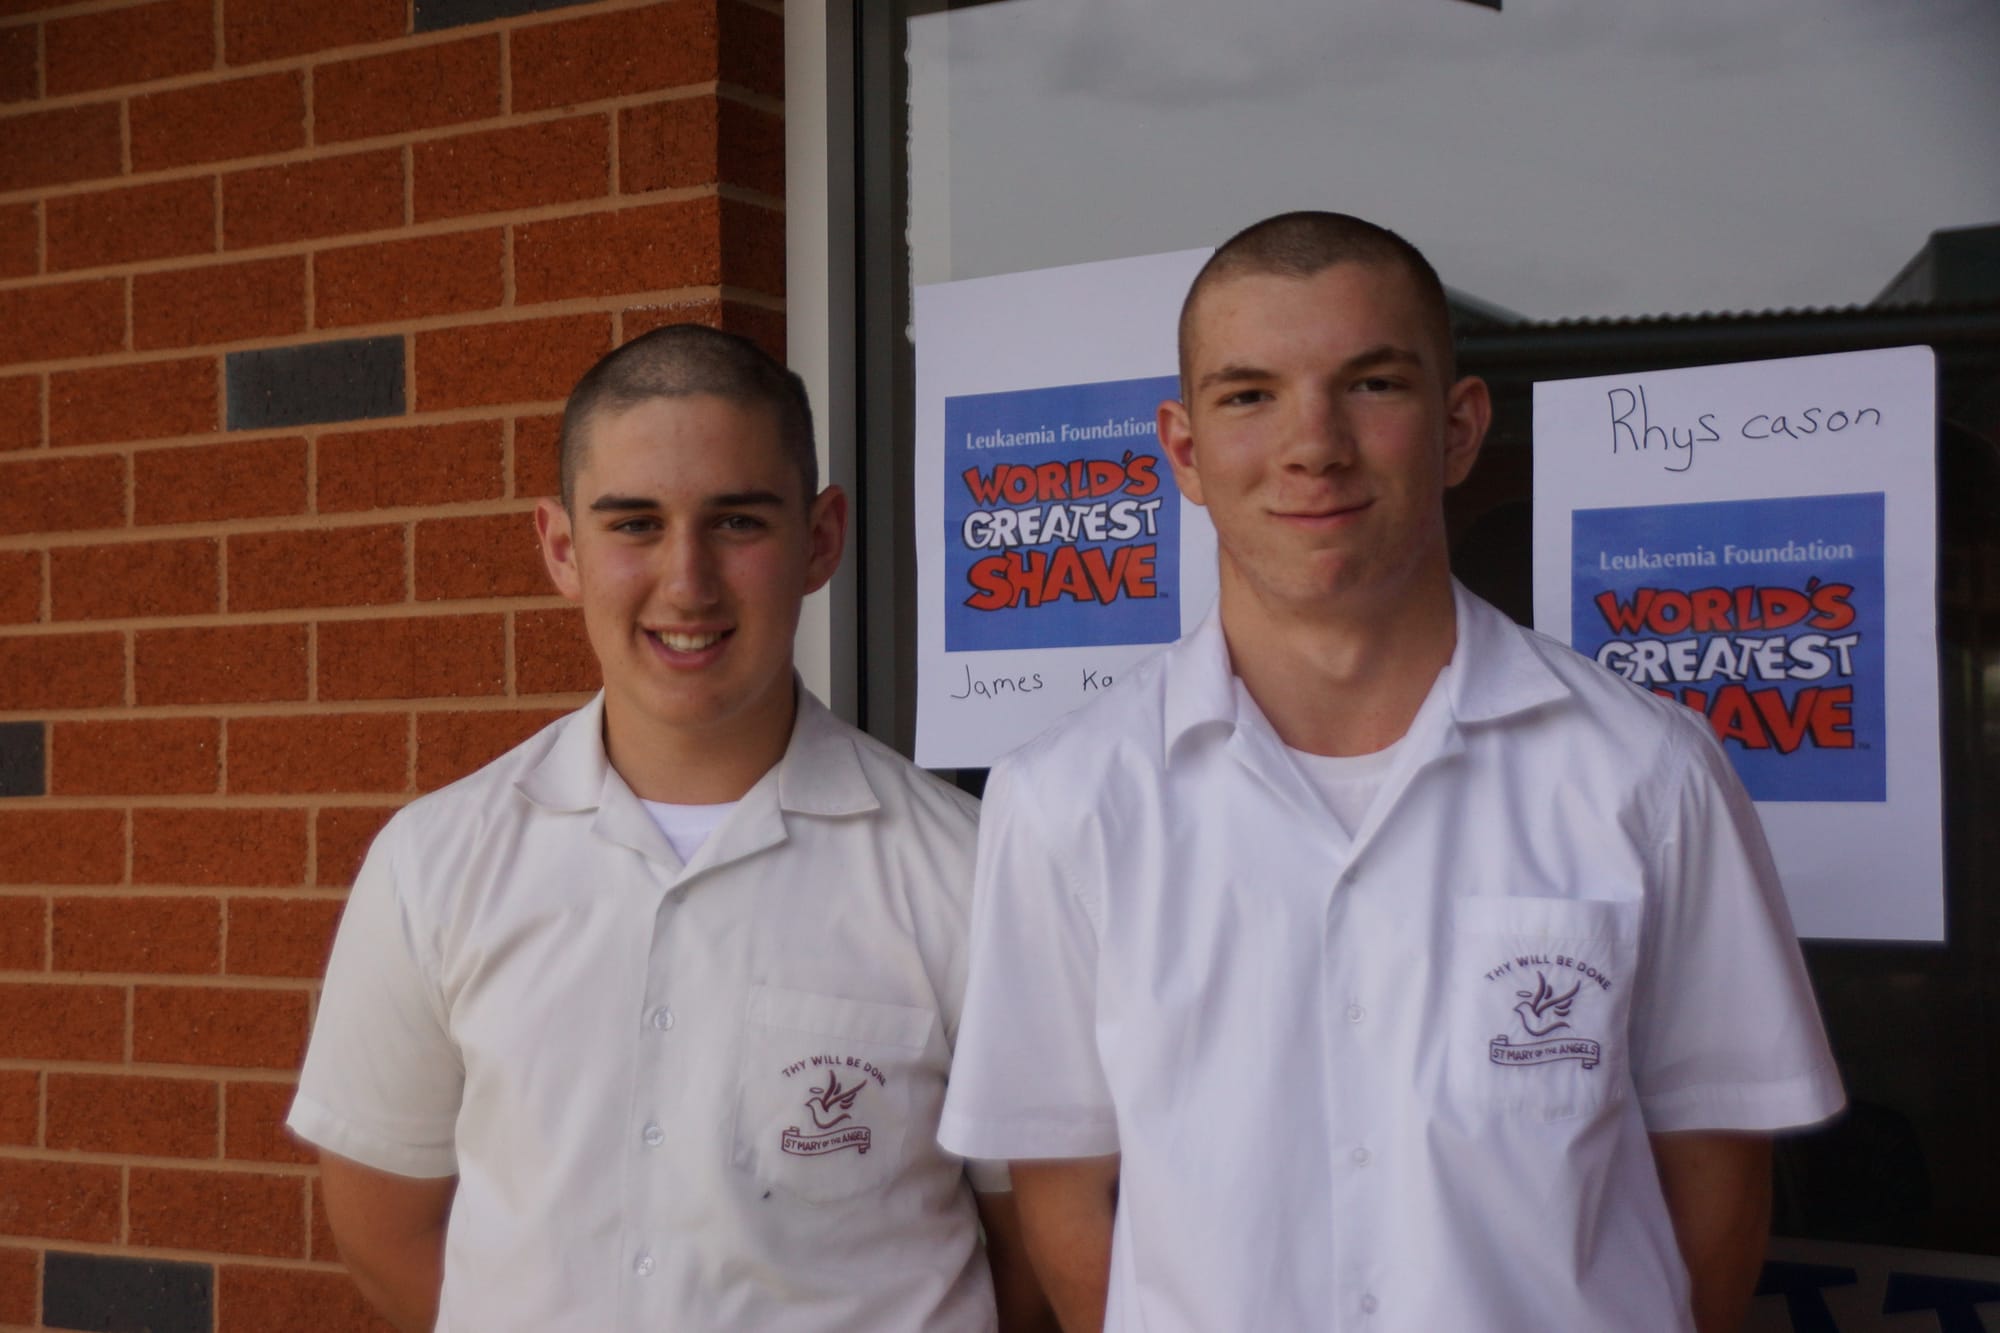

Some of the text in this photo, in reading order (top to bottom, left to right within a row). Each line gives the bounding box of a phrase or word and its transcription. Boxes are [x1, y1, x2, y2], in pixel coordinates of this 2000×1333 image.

[966, 417, 1157, 450] Leukaemia Foundation
[1607, 384, 1882, 472] Rhys cason
[962, 450, 1160, 506] WORLD'S
[963, 498, 1163, 550] GREATEST
[963, 542, 1157, 612] SHAVE
[1600, 539, 1854, 571] Leukaemia Foundation
[1594, 576, 1857, 636] WORLD'S
[1596, 631, 1862, 683] GREATEST
[950, 664, 1044, 699] James
[1652, 684, 1855, 754] AVE
[1485, 954, 1612, 990] THY WILL BE DONE
[782, 1061, 806, 1078] THY
[811, 1055, 842, 1066] WILL
[846, 1056, 862, 1068] BE
[1493, 1048, 1505, 1058] ST
[1507, 1049, 1533, 1060] MARY
[1558, 1043, 1597, 1055] ANGELS
[785, 1138, 797, 1148] ST
[798, 1140, 821, 1151] MARY
[842, 1131, 869, 1143] ANGELS
